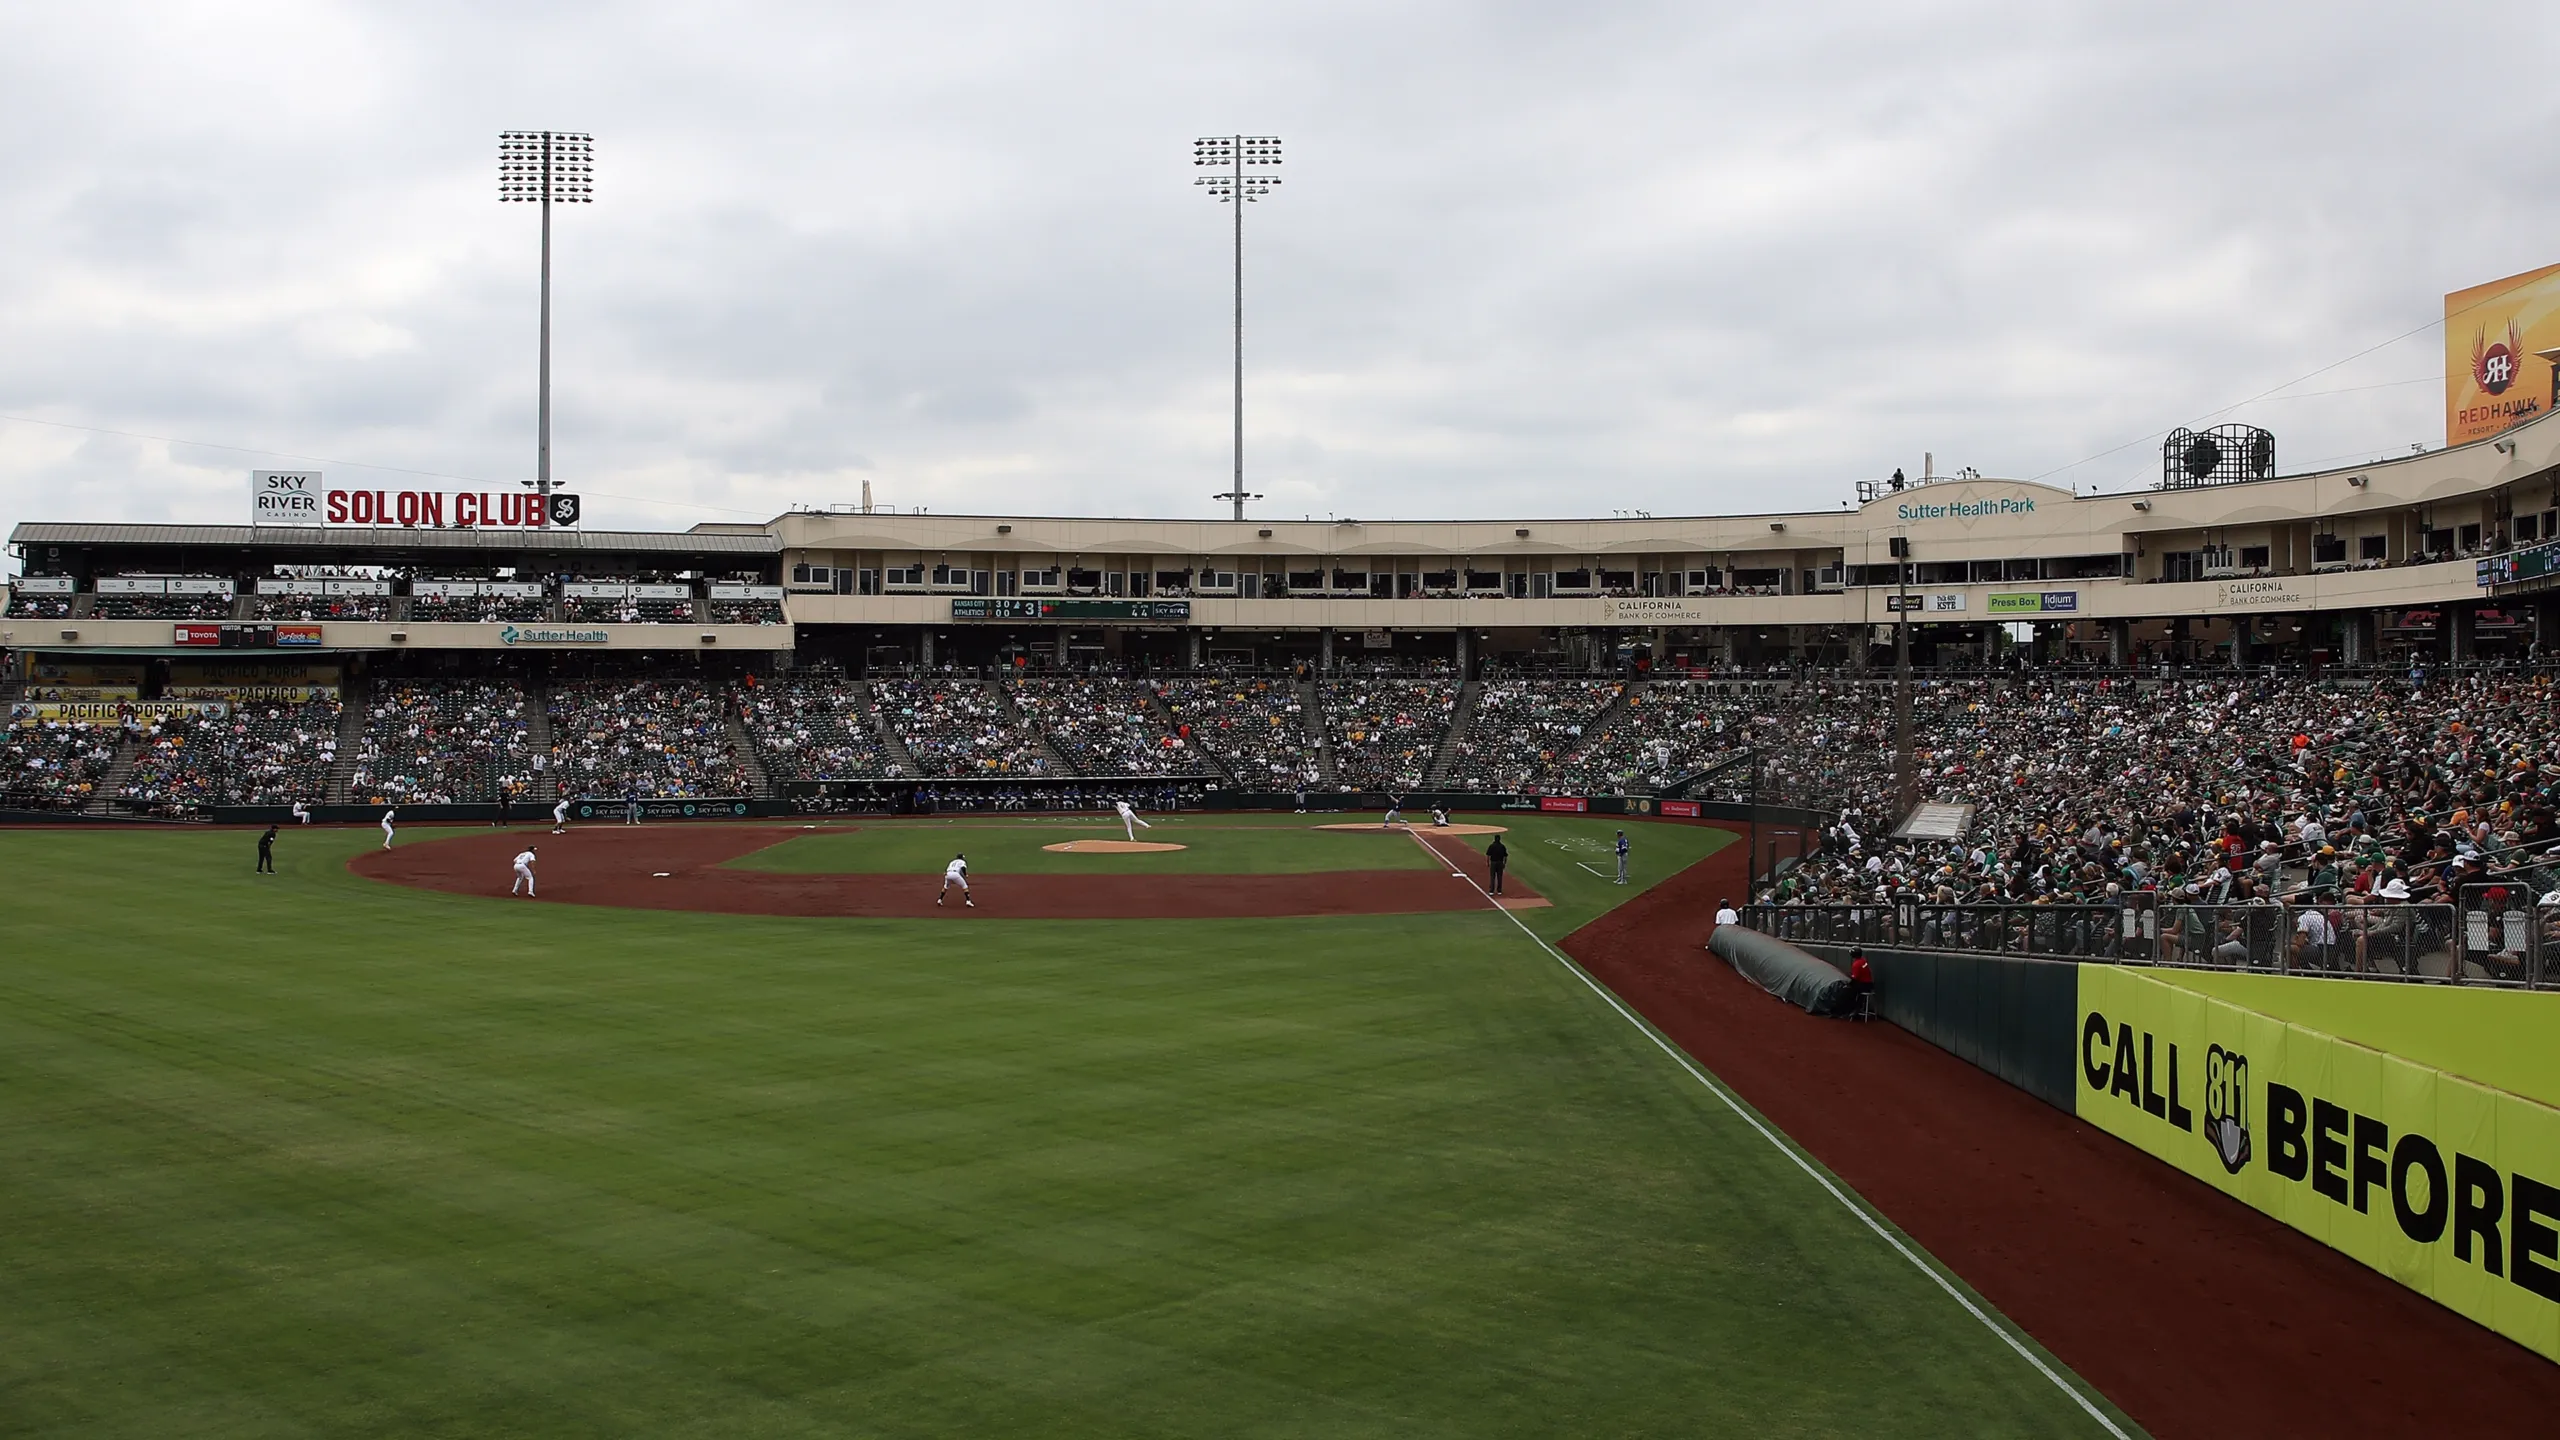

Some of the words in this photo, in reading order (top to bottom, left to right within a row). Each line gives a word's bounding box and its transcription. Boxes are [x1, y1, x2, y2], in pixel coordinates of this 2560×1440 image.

[2459, 397, 2537, 425] REDHAWK
[2468, 424, 2494, 435] RESORT
[267, 475, 307, 490] SKY
[258, 496, 316, 511] RIVER
[328, 490, 443, 526] SOLON
[455, 492, 546, 527] CLUB
[1898, 504, 1947, 519] Sutter
[1949, 500, 1998, 517] Health
[2000, 497, 2035, 514] Park
[2229, 582, 2283, 594] CALIFORNIA
[995, 600, 1002, 608] 3
[1003, 600, 1010, 608] 0
[1618, 601, 1682, 610] CALIFORNIA
[1937, 601, 1957, 610] KSTE
[1991, 598, 2017, 608] Press
[2019, 597, 2036, 606] Box
[2230, 597, 2248, 605] BANK
[2249, 596, 2259, 604] OF
[2260, 594, 2300, 604] COMMERCE
[995, 609, 1002, 617] 0
[1003, 609, 1010, 617] 0
[1025, 602, 1035, 616] 3
[523, 629, 564, 641] Sutter
[566, 629, 609, 641] Health
[202, 666, 259, 679] PACIFICO
[266, 666, 307, 678] PORCH
[239, 687, 298, 700] PACIFICO
[59, 703, 126, 718] PACIFIC
[2082, 1011, 2192, 1134] CALL
[2206, 1043, 2249, 1131] 811
[2266, 1081, 2560, 1304] BEFORE
